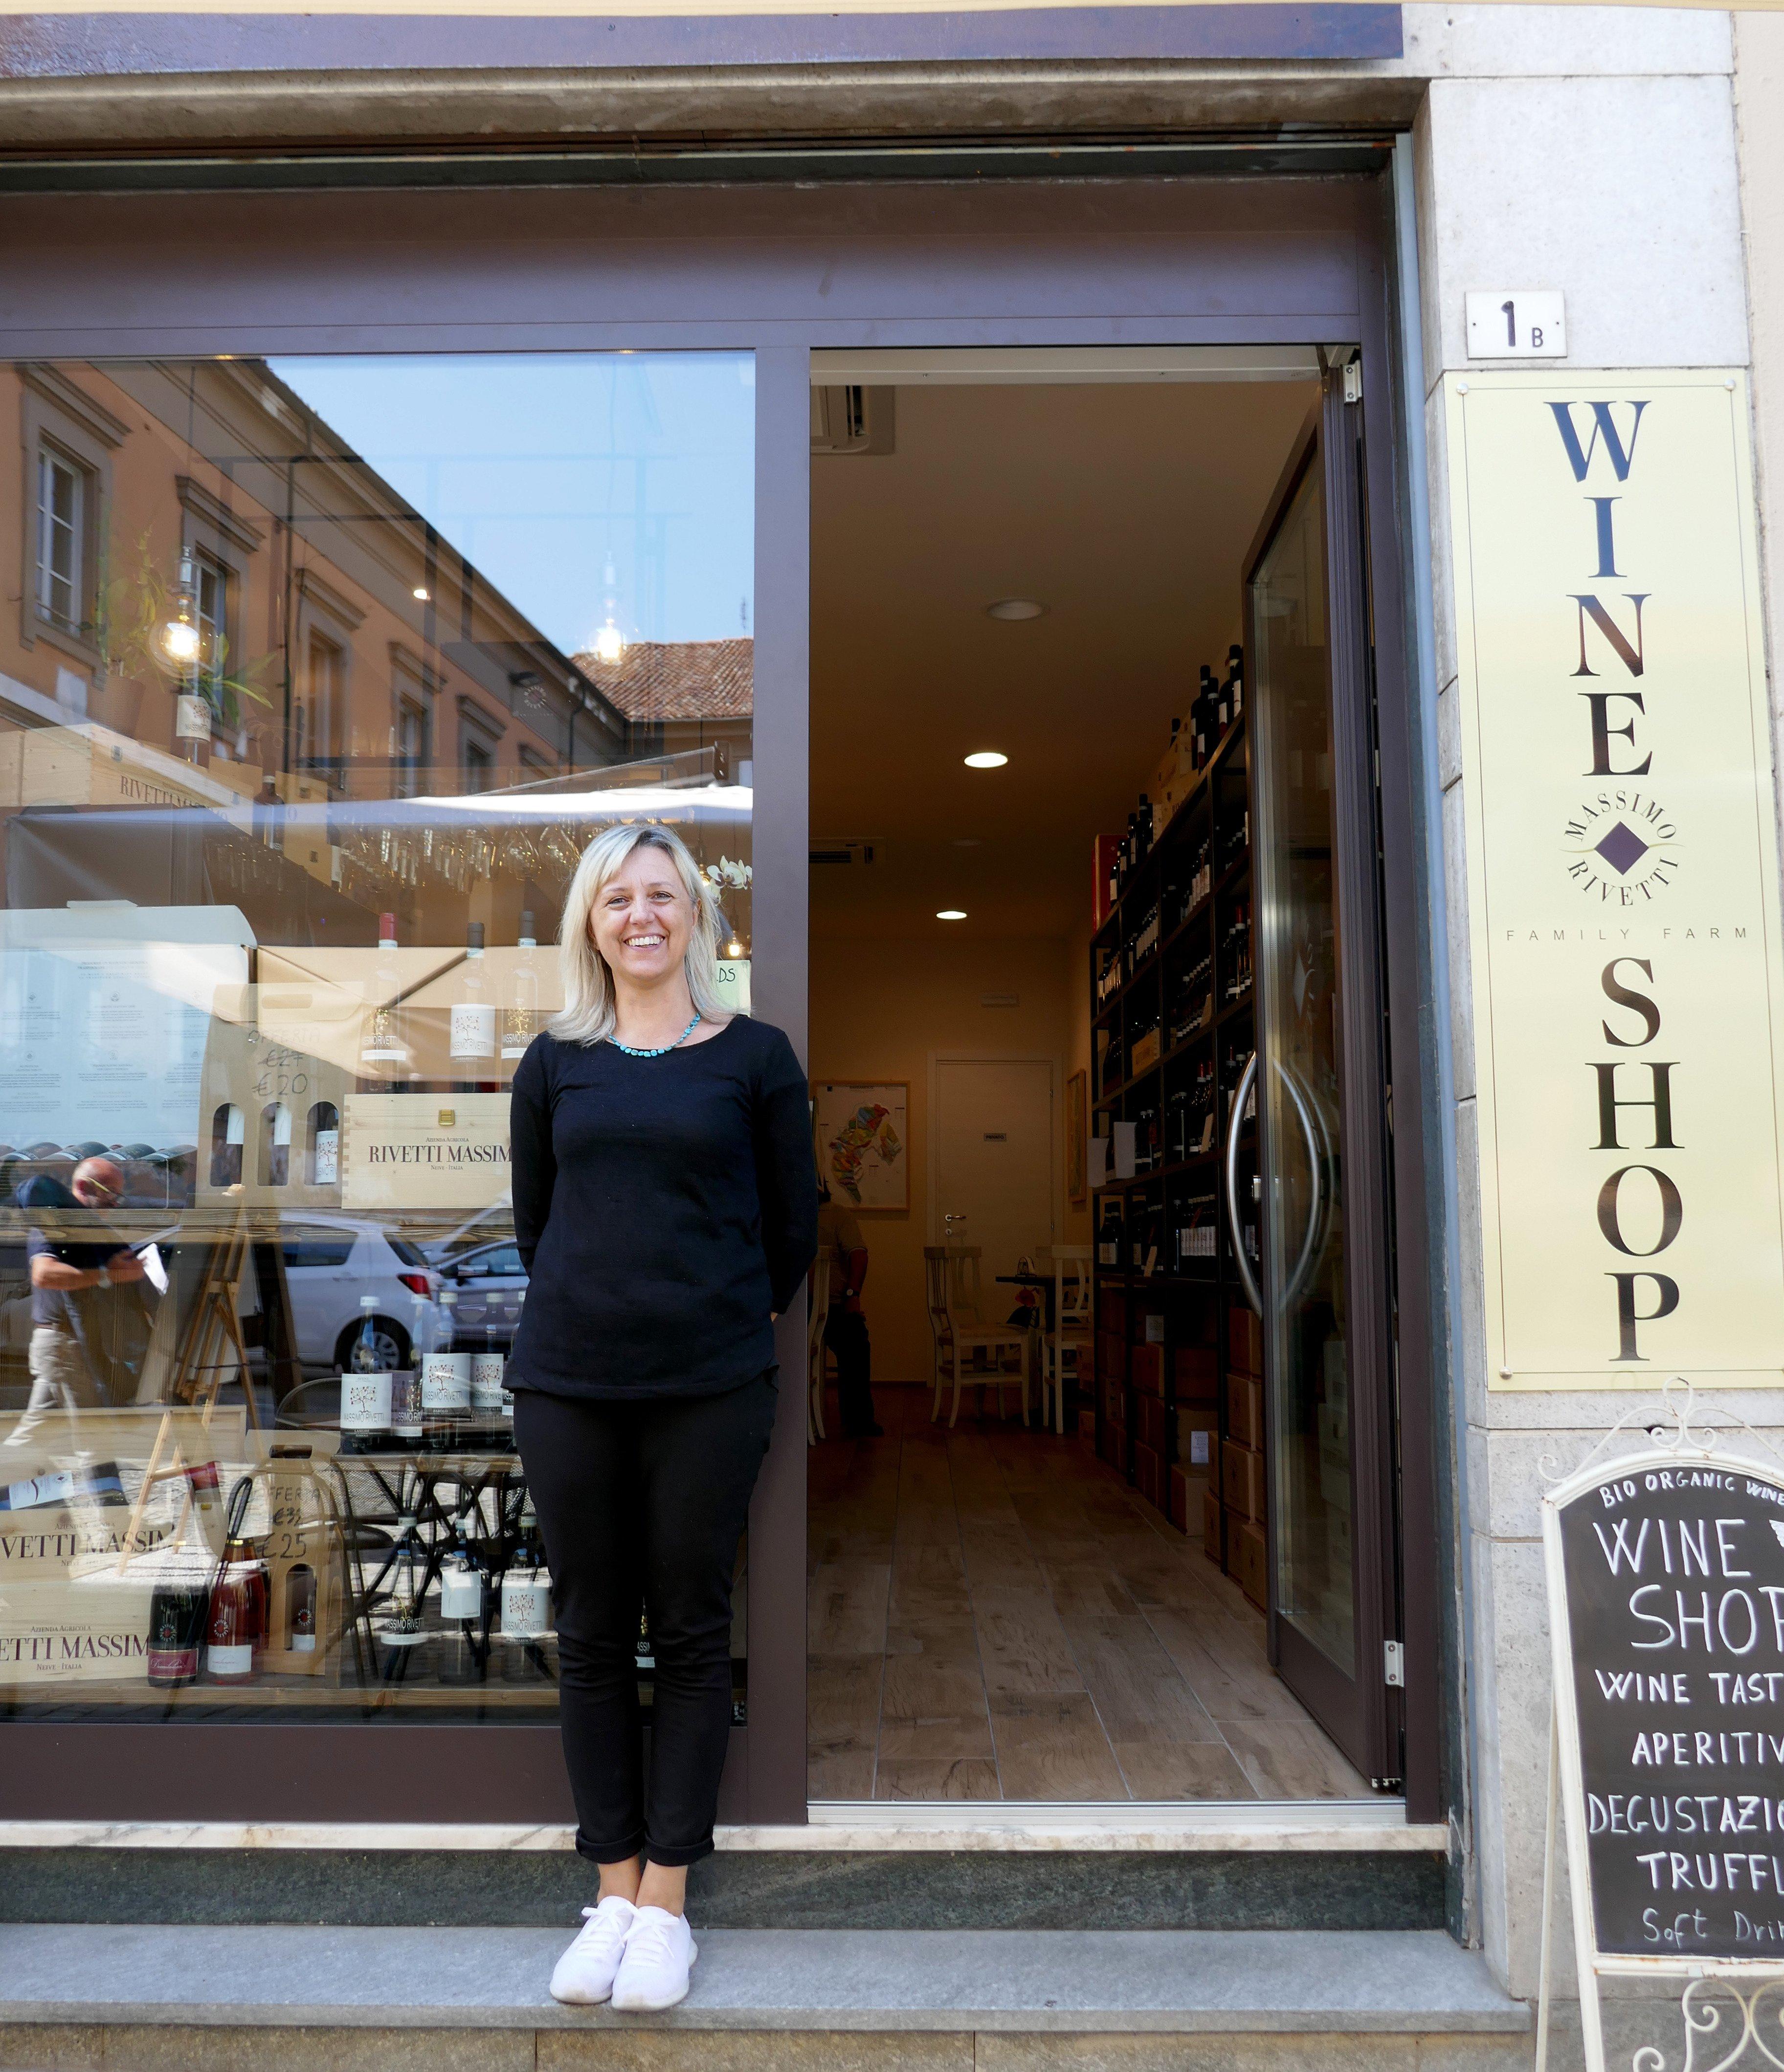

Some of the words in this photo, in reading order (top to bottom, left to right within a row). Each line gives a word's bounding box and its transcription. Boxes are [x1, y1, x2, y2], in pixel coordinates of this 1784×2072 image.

[1500, 300, 1516, 348] 1
[1532, 327, 1544, 348] B
[1543, 400, 1653, 776] WINE
[1563, 790, 1676, 842] MASSIMO
[1567, 857, 1679, 906] RIVETTI
[1506, 929, 1630, 941] FAMILY
[1663, 928, 1746, 939] FARM
[717, 967, 736, 983] DS
[251, 1072, 308, 1096] €20
[368, 1145, 443, 1163] RIVETTI
[1584, 957, 1685, 1363] SHOP
[1599, 1480, 1637, 1508] BIO
[1645, 1471, 1736, 1492] ORGANIC
[256, 1532, 307, 1559] €25
[1592, 1518, 1751, 1577] WINE
[1595, 1669, 1690, 1704] WINE
[1708, 1672, 1784, 1705] TAST
[1642, 1907, 1708, 1949] Soft
